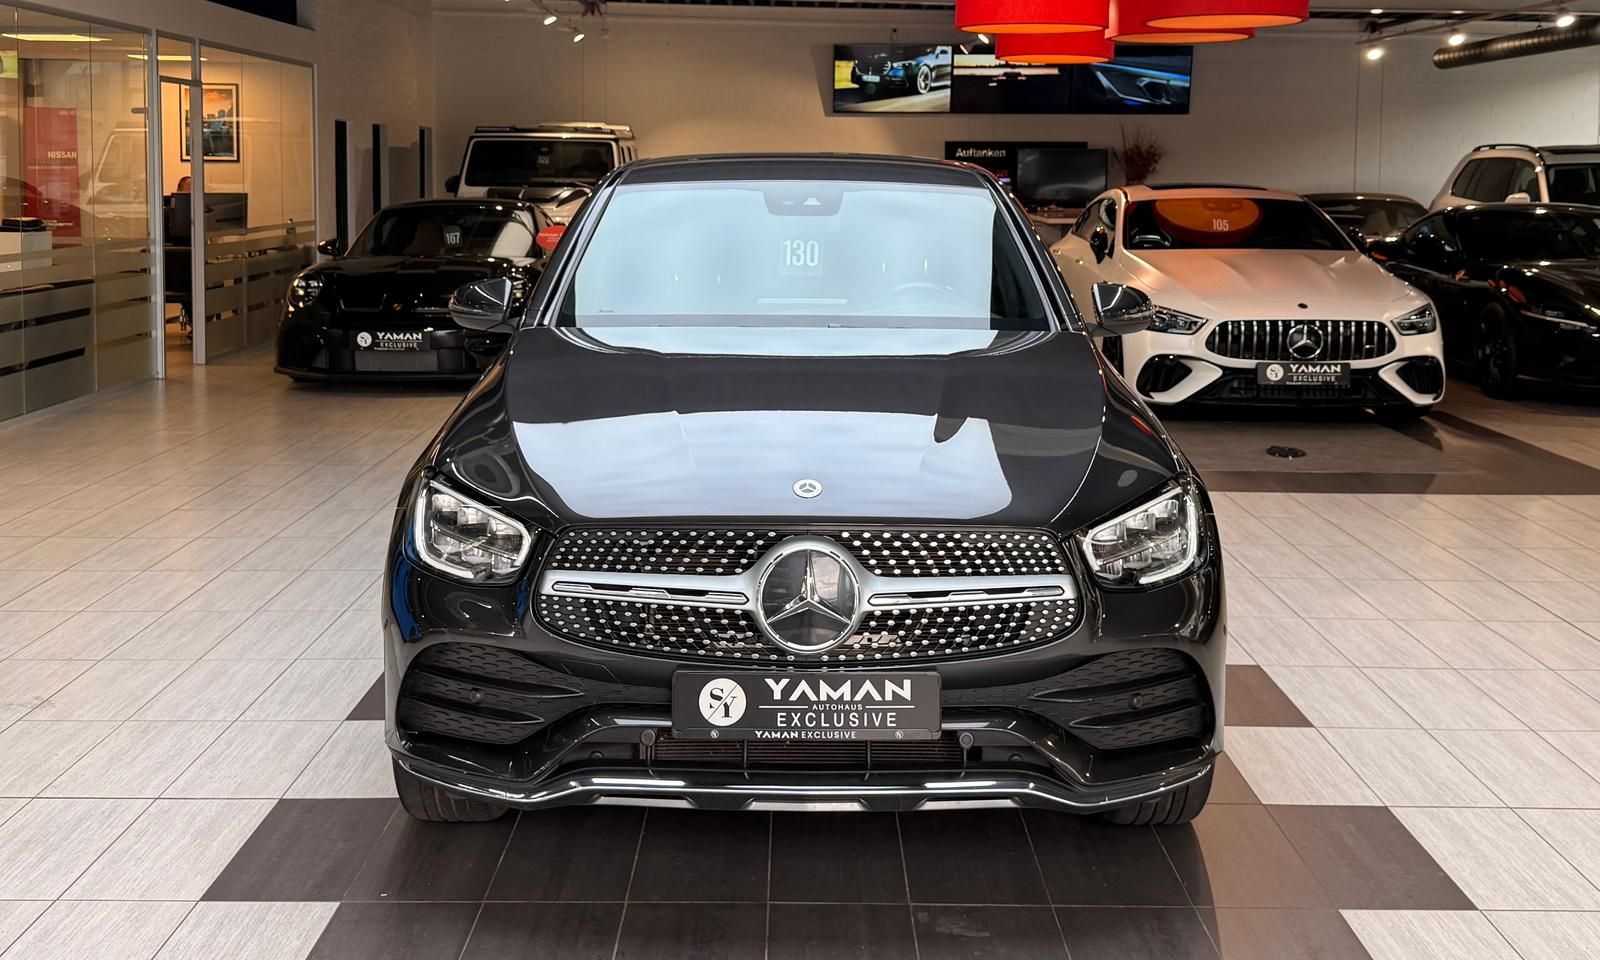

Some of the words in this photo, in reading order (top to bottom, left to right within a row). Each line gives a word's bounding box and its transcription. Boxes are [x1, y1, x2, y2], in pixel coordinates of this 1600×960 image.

[48, 151, 77, 159] NISSAN
[955, 147, 1006, 158] Auftanken
[1212, 218, 1229, 231] 105
[446, 232, 460, 244] 167
[784, 240, 819, 267] 130
[376, 332, 422, 340] YAMAN
[1290, 364, 1341, 373] YAMAN
[764, 678, 912, 701] YAMAN
[777, 713, 897, 728] EXCLUSIVE
[755, 731, 799, 739] YAMAN
[801, 731, 857, 739] EXCLUSIVE
